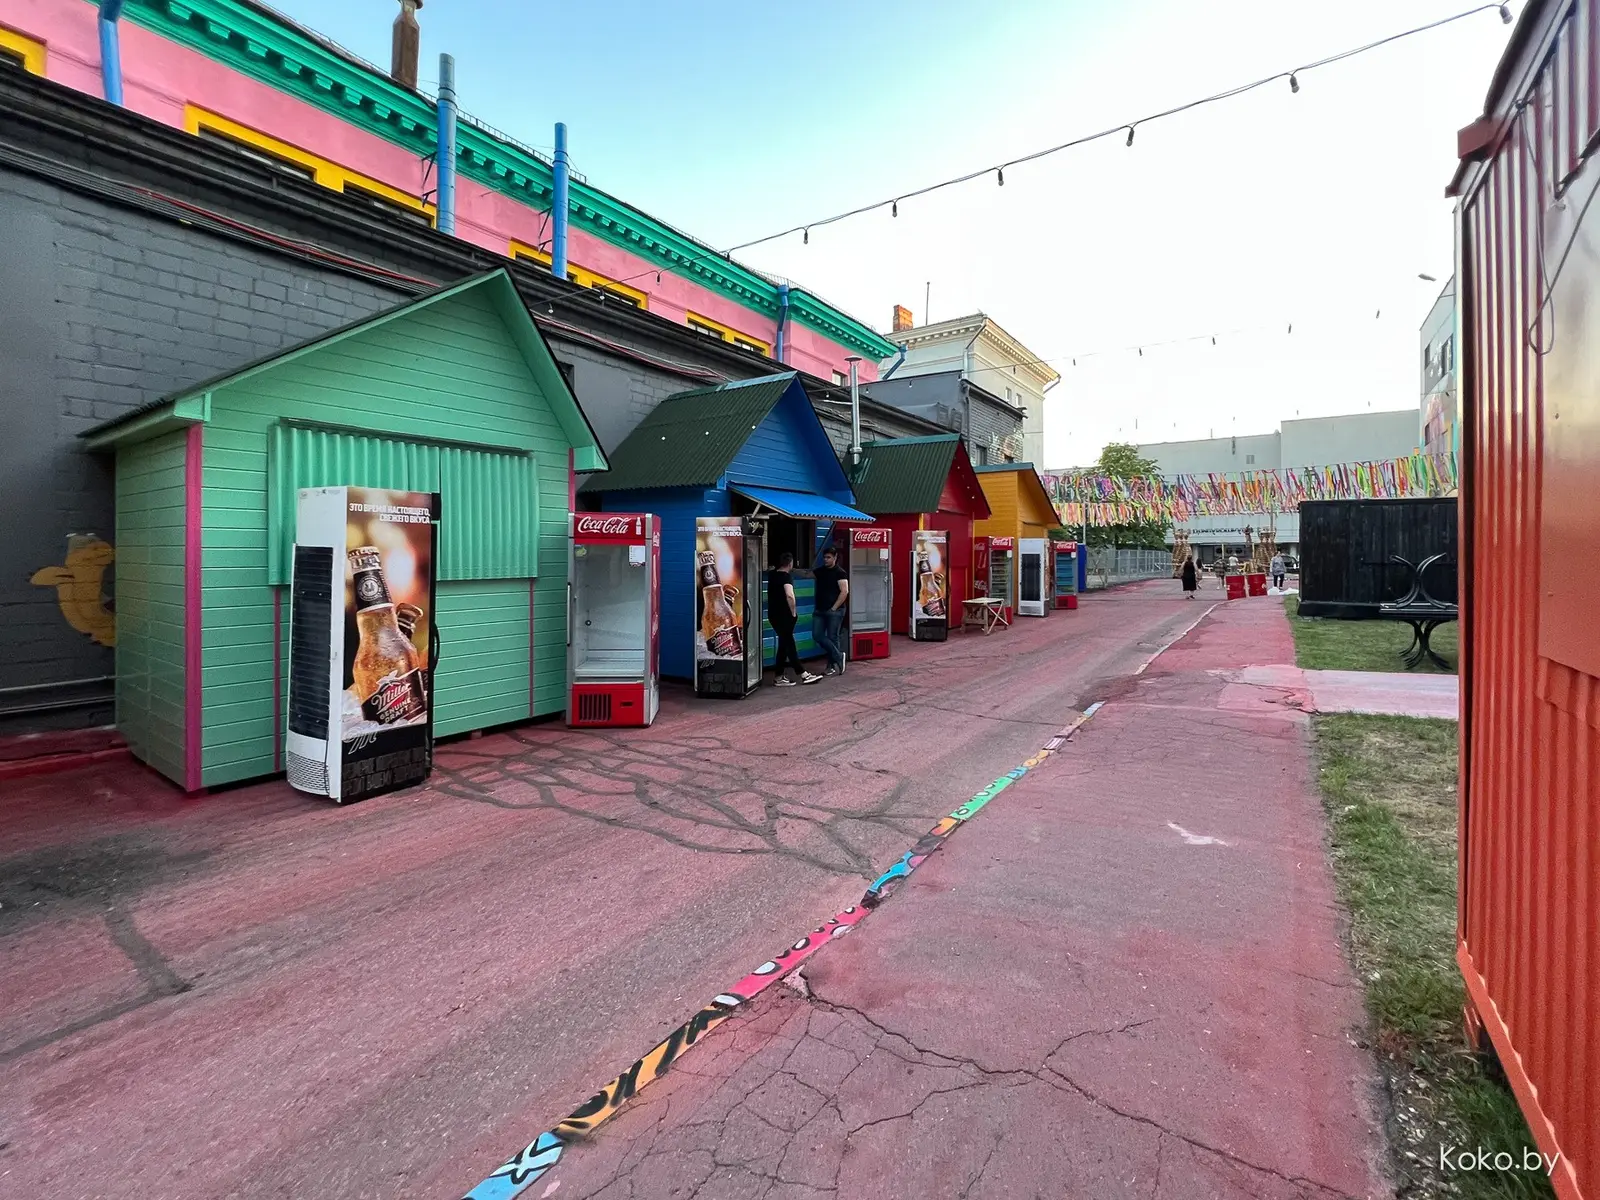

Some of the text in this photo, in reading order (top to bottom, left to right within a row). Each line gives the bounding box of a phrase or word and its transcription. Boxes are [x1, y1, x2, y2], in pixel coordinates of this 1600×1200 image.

[349, 503, 363, 511] ЭТО
[409, 515, 430, 523] ВКУСА
[577, 516, 633, 534] Coca-Cola
[371, 682, 412, 711] Miller
[379, 697, 412, 720] GENUINE
[384, 705, 409, 723] DRAFT
